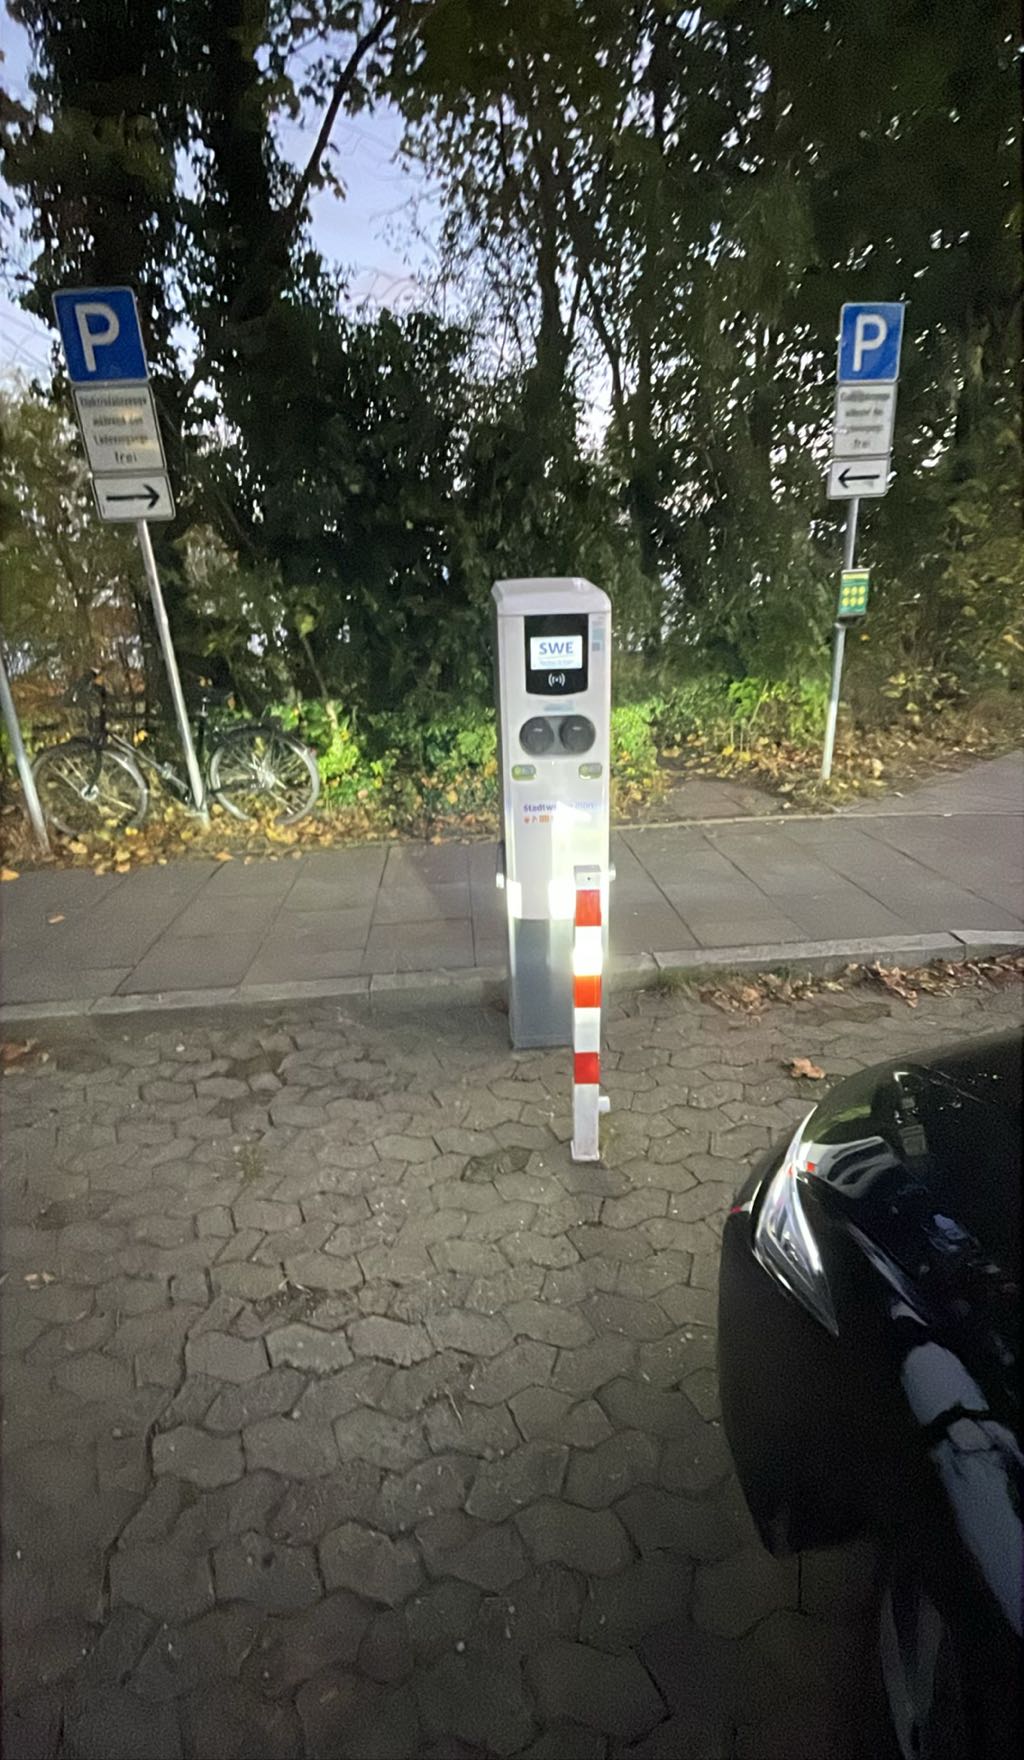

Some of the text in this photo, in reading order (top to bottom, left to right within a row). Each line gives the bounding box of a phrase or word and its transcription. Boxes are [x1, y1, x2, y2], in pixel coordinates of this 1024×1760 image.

[74, 302, 120, 372] P
[852, 313, 888, 372] P
[538, 641, 574, 655] SWE
